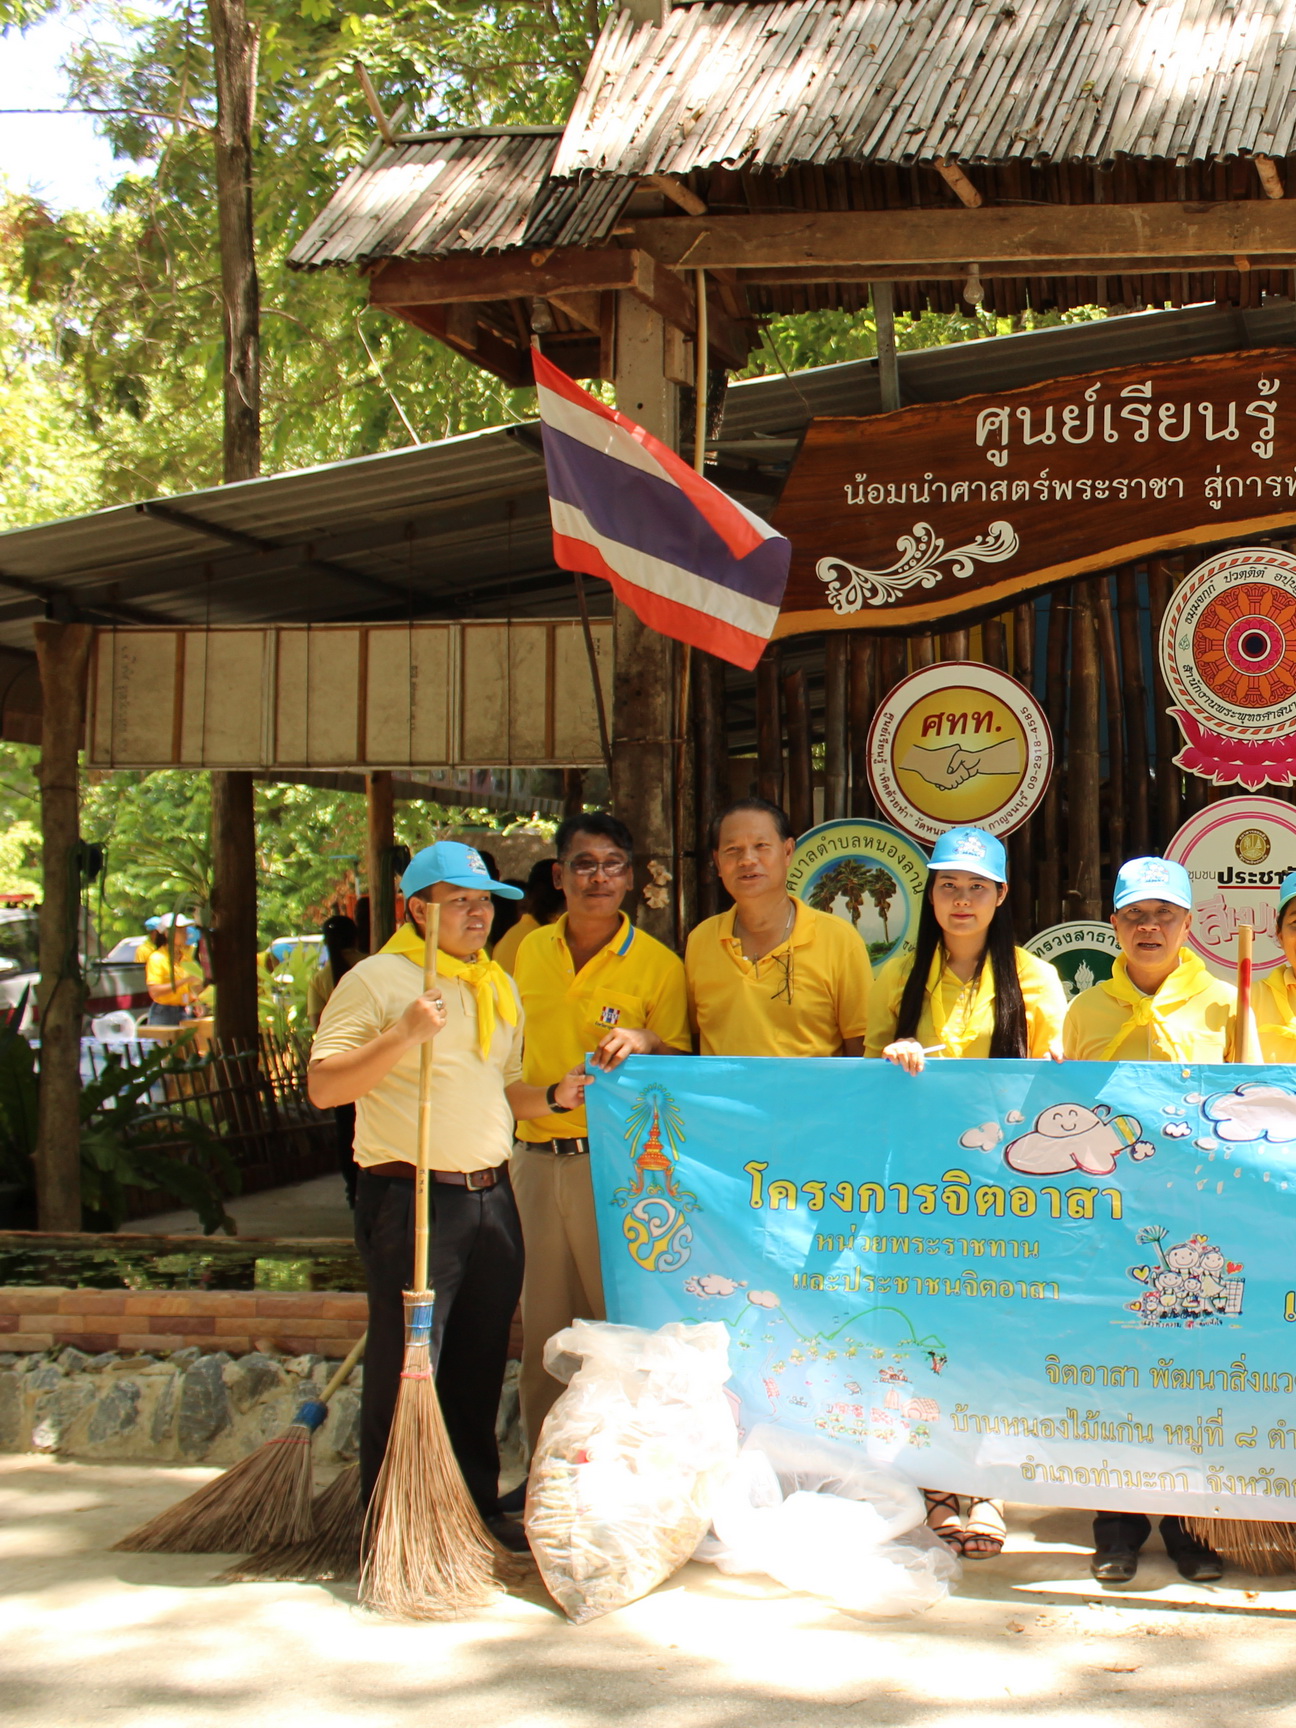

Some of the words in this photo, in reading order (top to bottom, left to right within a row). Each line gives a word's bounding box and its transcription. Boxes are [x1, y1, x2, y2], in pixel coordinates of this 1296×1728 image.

[975, 377, 1281, 467] ศูนย์เรียนรู้
[843, 467, 1185, 506] น้อมนำศาสตร์พระราชา
[921, 710, 1002, 738] ศทท.
[988, 790, 1029, 832] กาญจนบุรี
[1020, 706, 1048, 791] 09-2918-4585
[785, 835, 925, 895] ศบาลตำบลหนองลาน
[743, 1159, 1124, 1221] โครงการจิตอาสา
[814, 1223, 1040, 1260] หน่วยพระราชทาน
[792, 1264, 1061, 1301] และประชาชนจิตอาสา
[1043, 1353, 1140, 1389] จิตอาสา
[949, 1402, 1155, 1443] บ้านหนองไม้แก่น
[1164, 1407, 1225, 1456] หมู่ที่
[1234, 1427, 1259, 1450] ๘
[1019, 1454, 1190, 1494] อำเภอท่ามะกา
